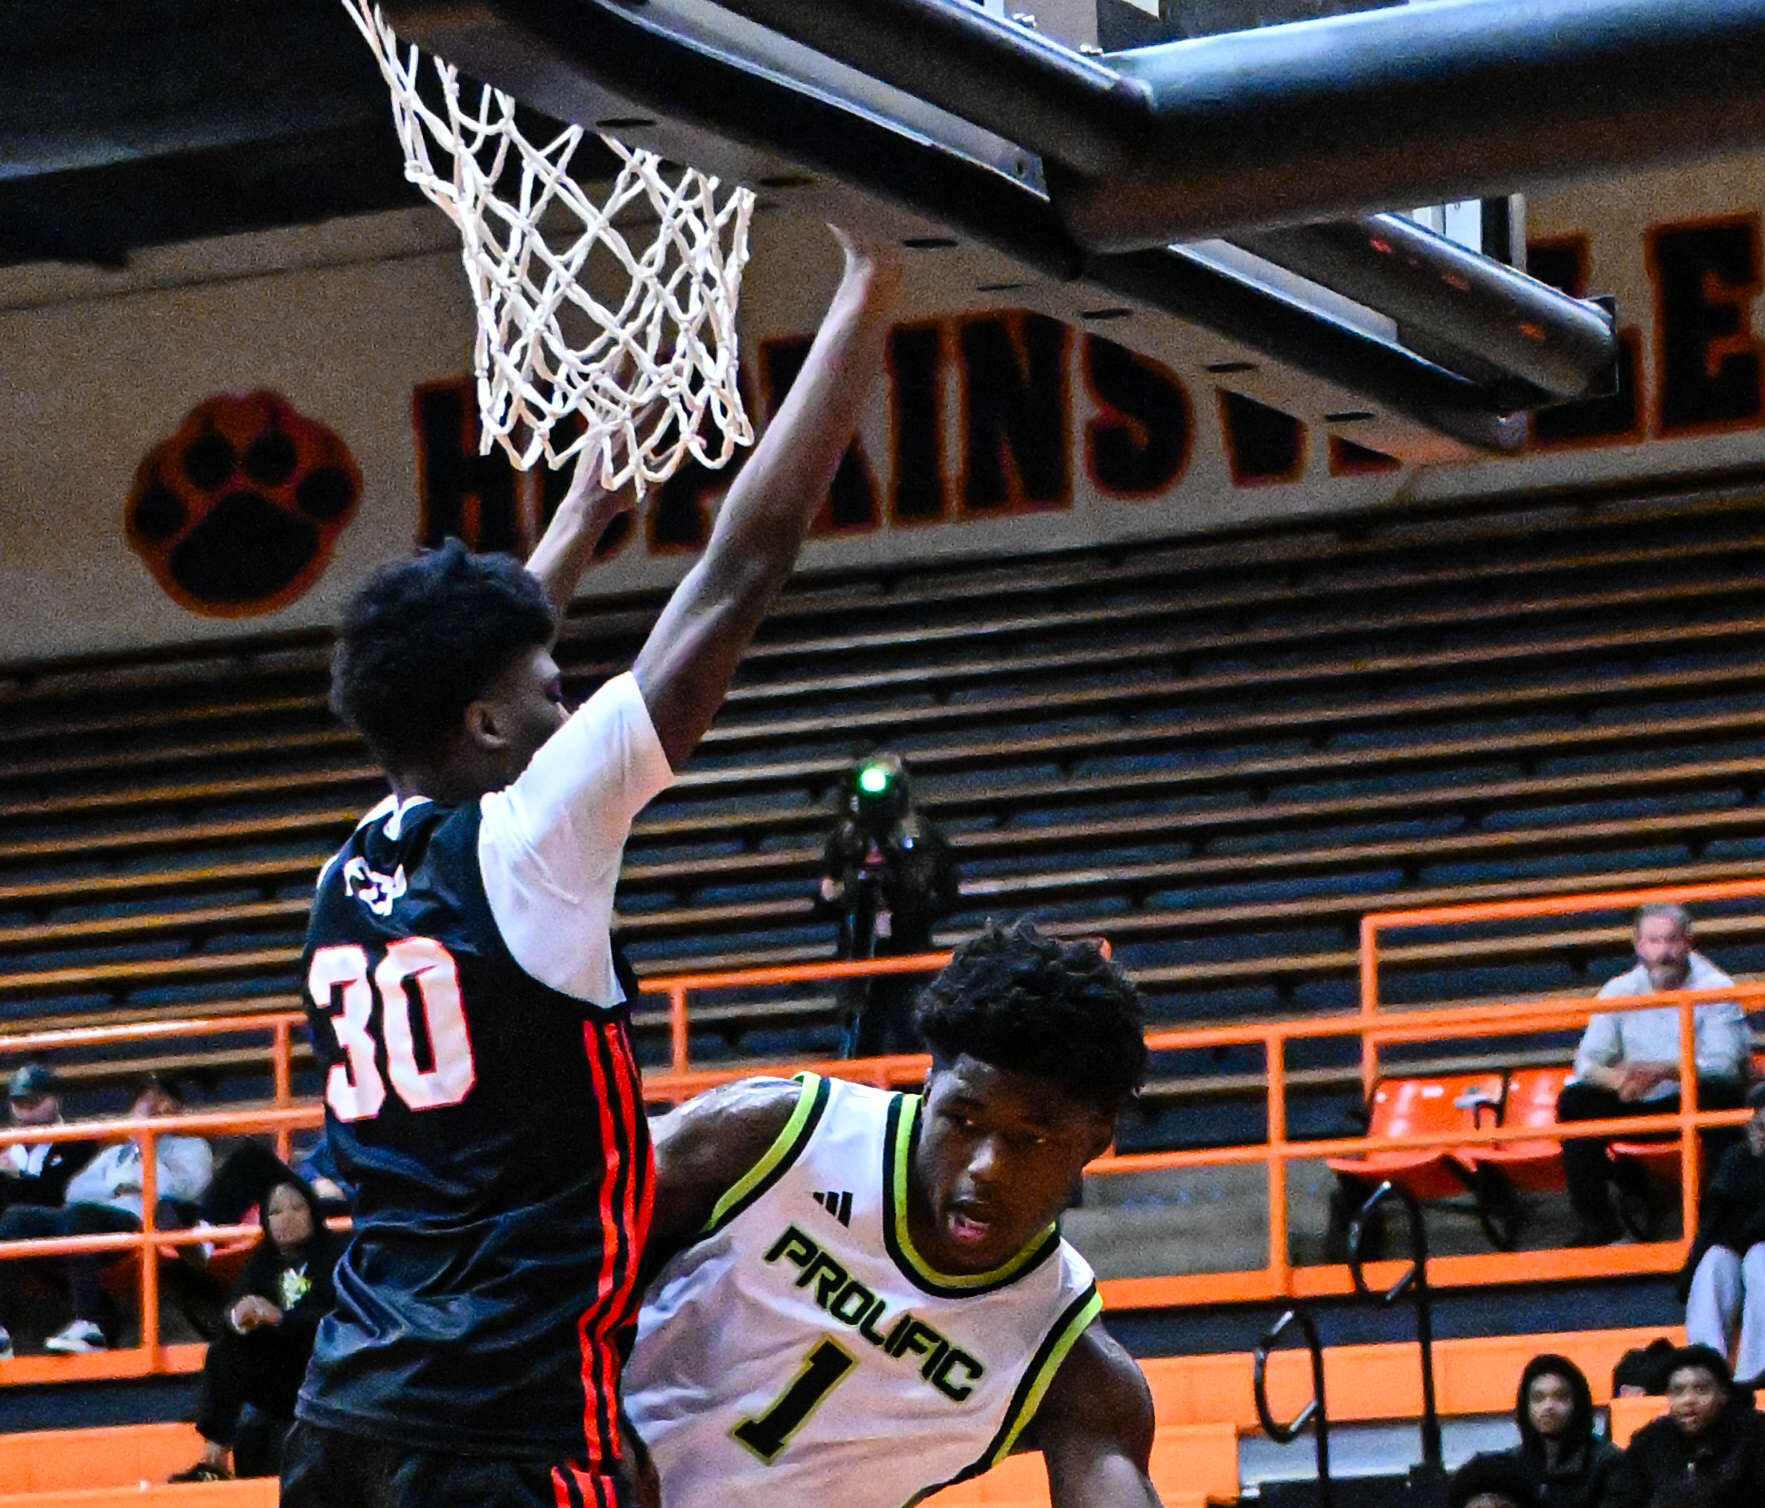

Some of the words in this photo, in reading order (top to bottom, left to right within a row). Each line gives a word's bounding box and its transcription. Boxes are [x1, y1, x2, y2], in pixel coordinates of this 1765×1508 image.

[308, 936, 477, 1122] 30
[730, 1334, 857, 1466] 1
[763, 1224, 984, 1402] PROLIFIC
